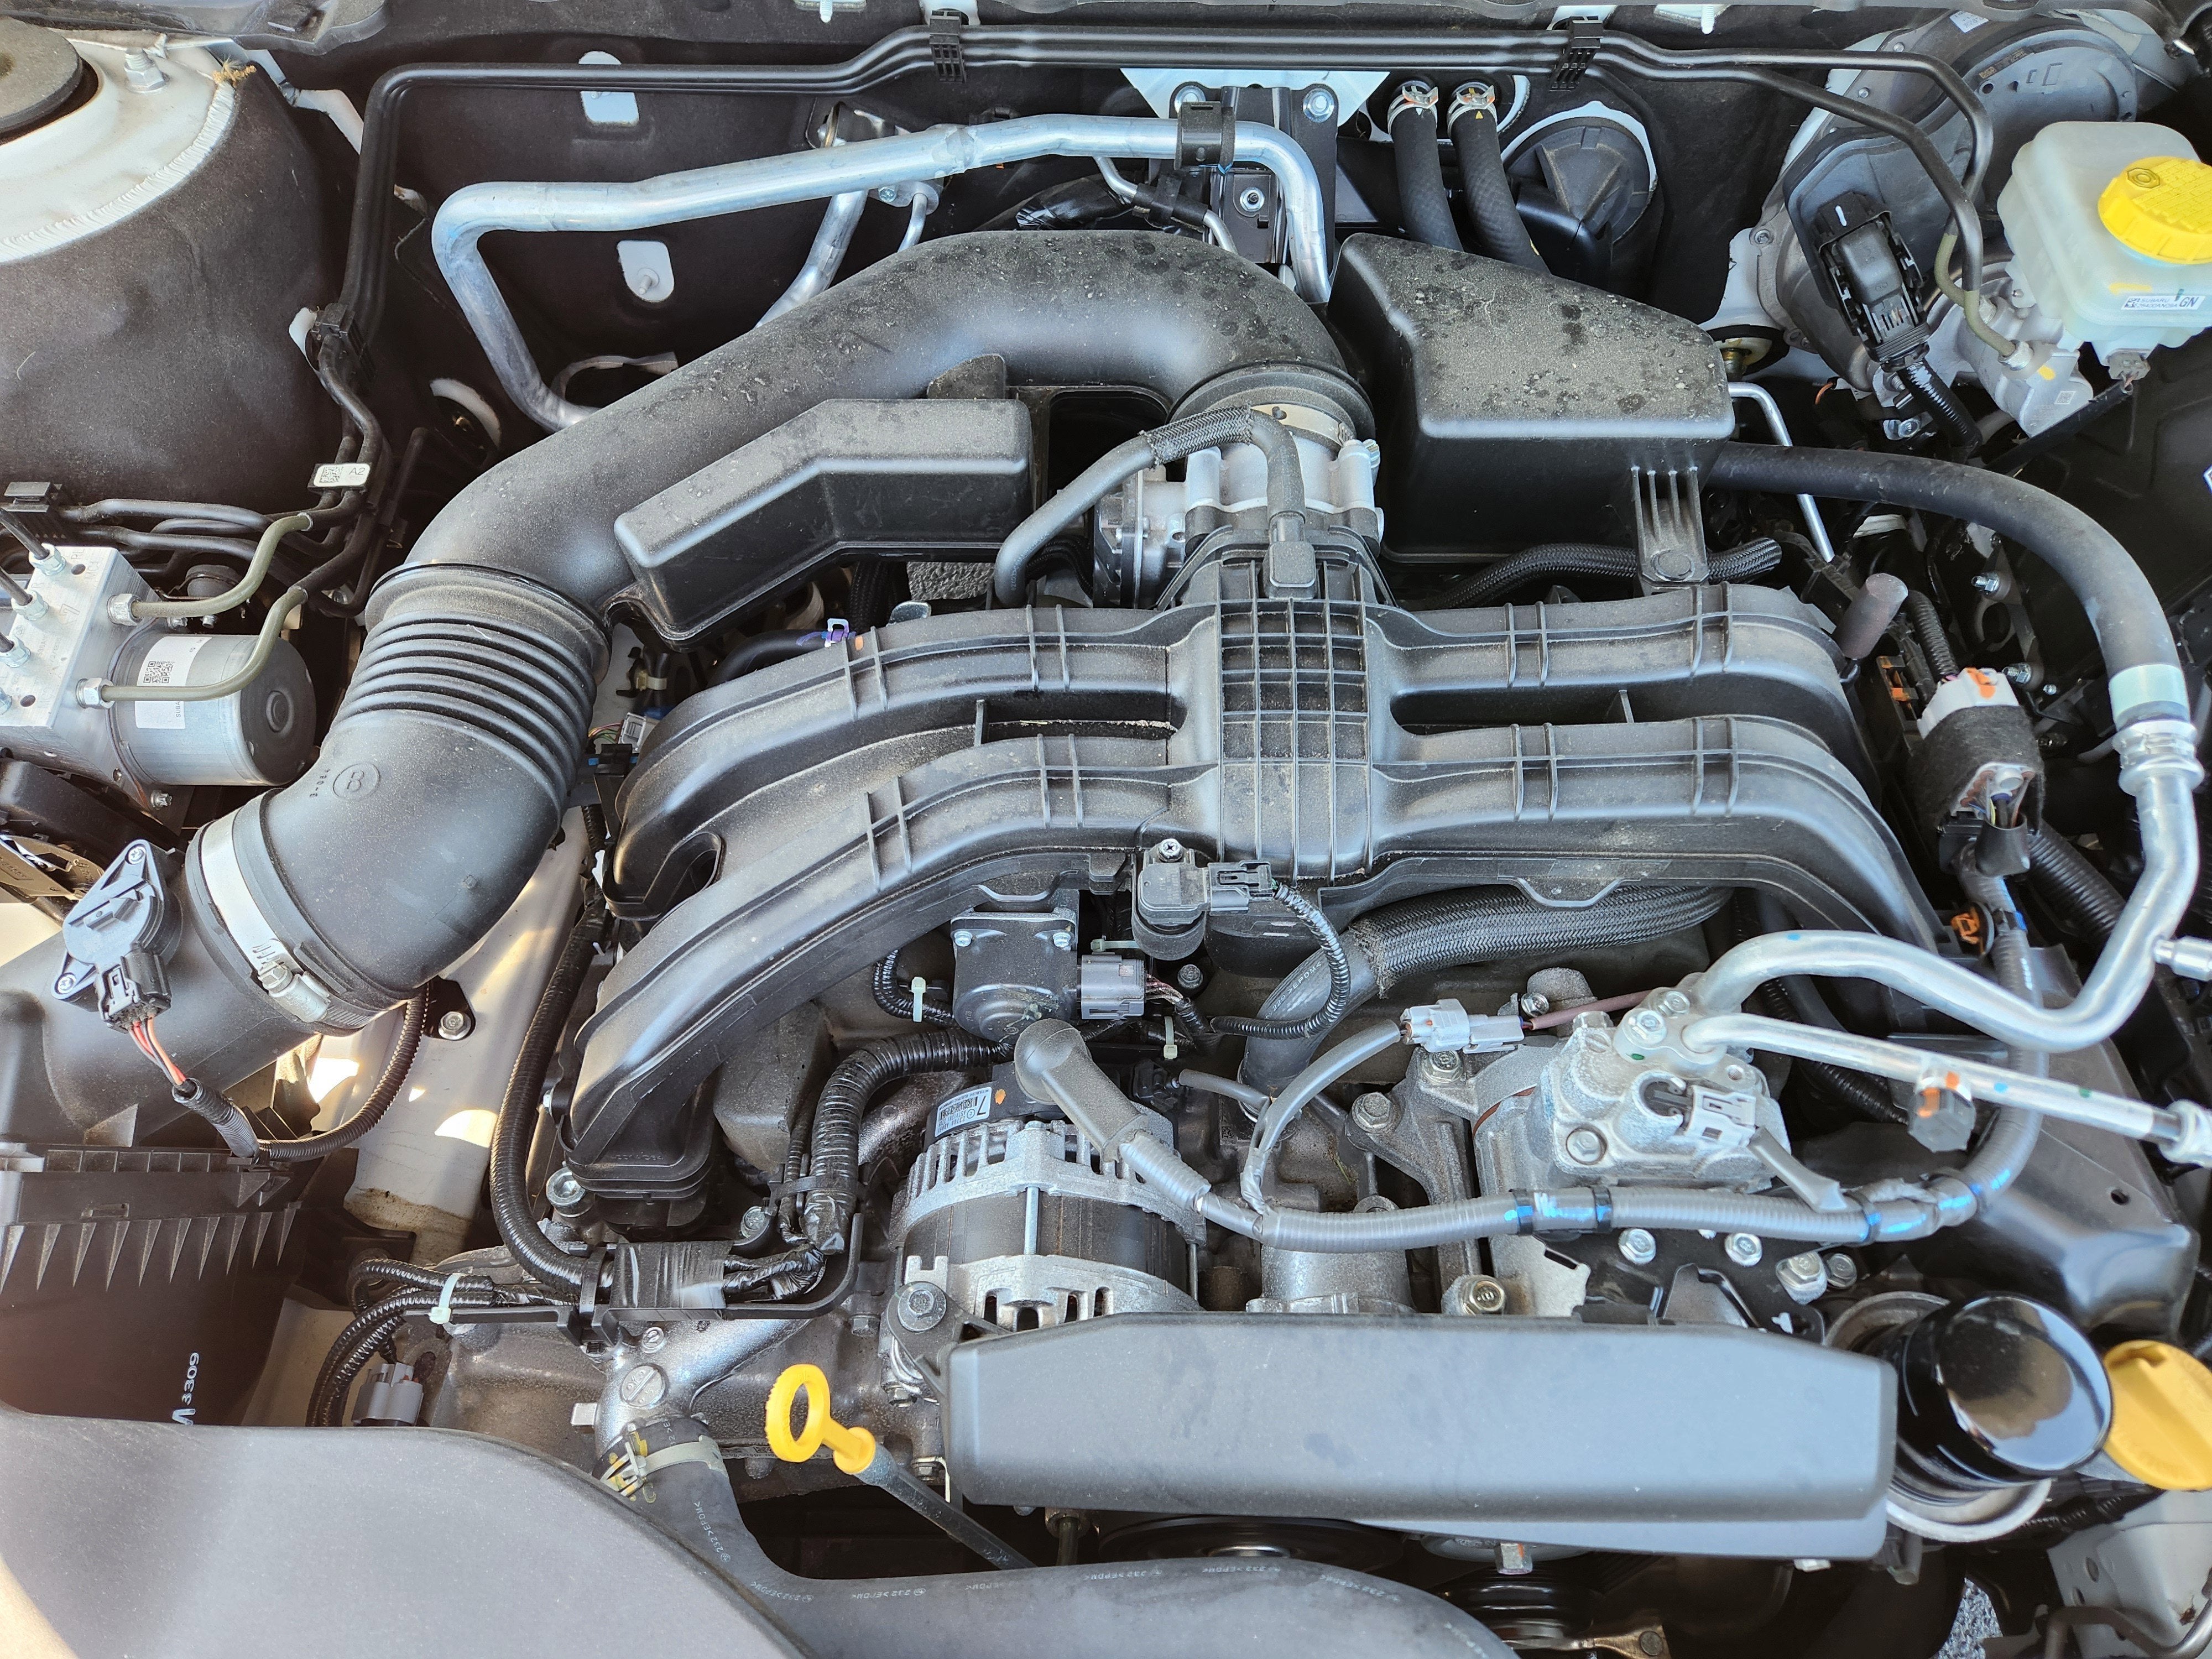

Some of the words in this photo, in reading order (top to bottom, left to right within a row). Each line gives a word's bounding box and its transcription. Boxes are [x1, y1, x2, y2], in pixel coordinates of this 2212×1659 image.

[2179, 296, 2199, 307] GN
[348, 467, 366, 476] A2
[977, 1095, 987, 1115] 7
